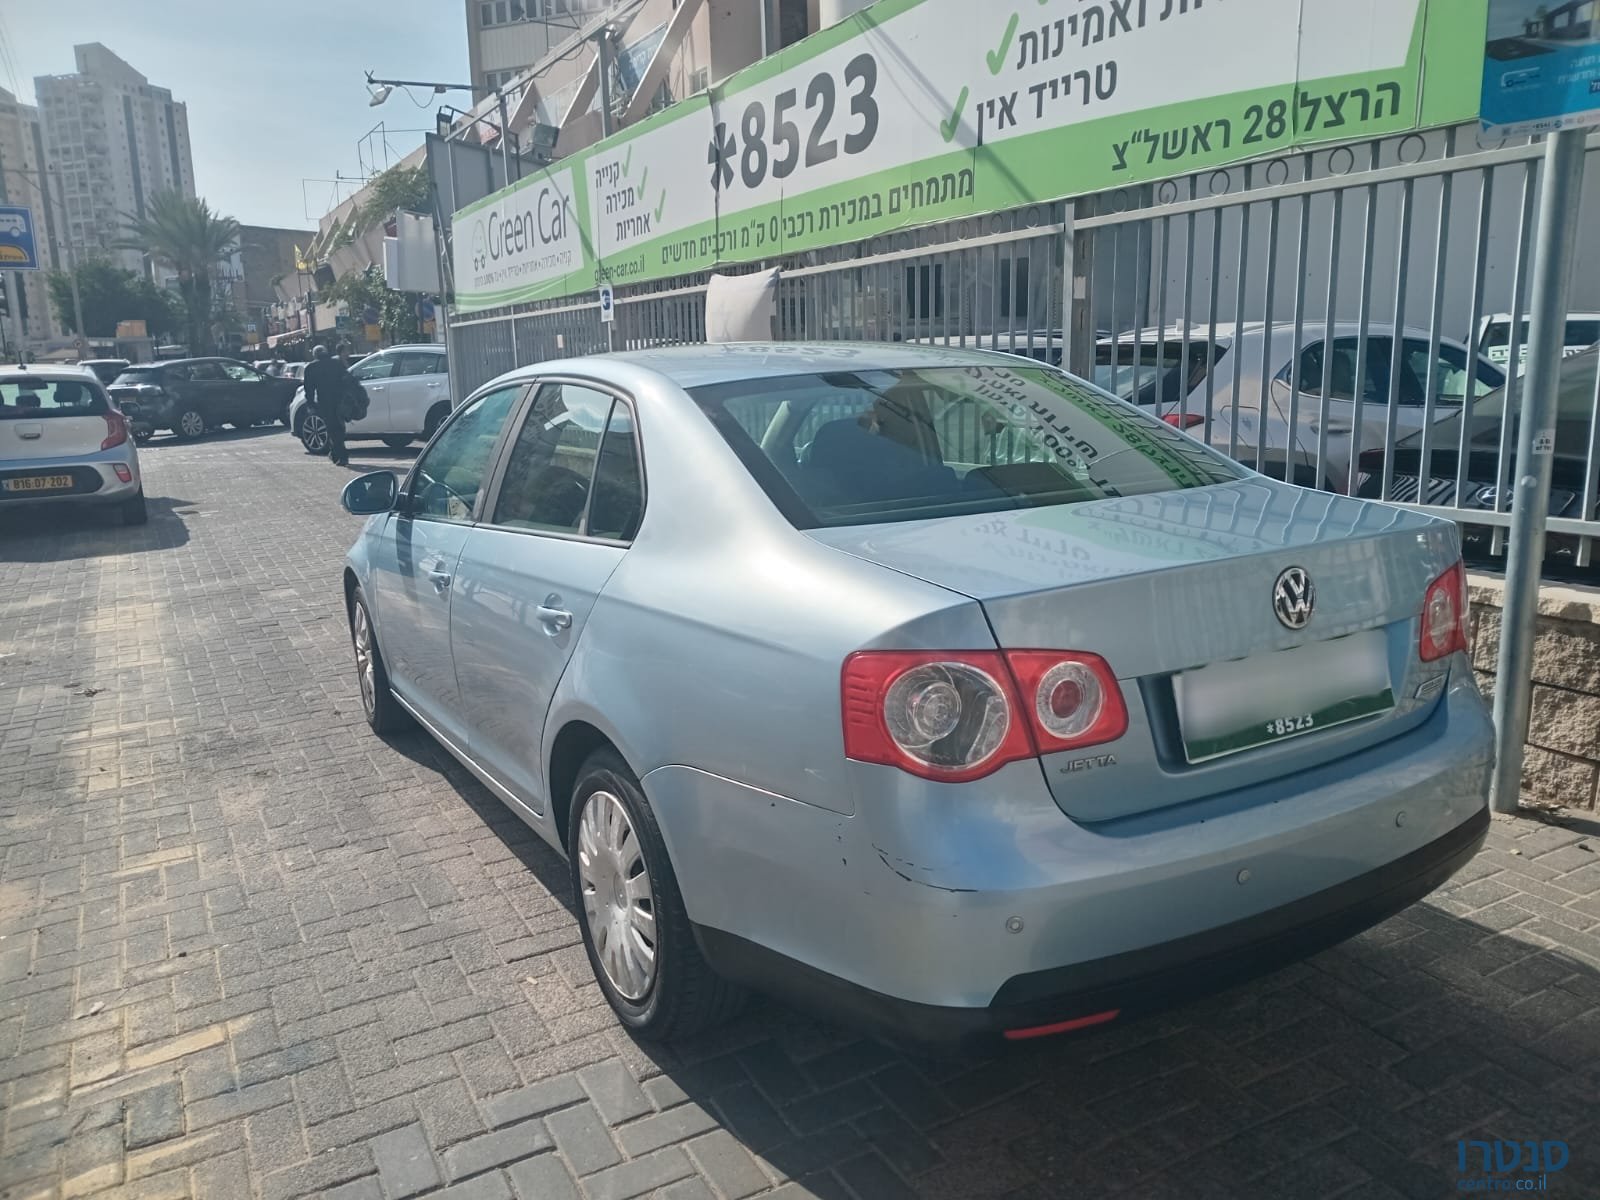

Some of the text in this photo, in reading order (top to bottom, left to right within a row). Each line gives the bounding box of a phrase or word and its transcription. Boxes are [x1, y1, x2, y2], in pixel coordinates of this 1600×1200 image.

[1016, 0, 1147, 71] ואמינות
[976, 60, 1118, 147] טרייד אין
[1299, 81, 1401, 132] הרצל
[1242, 99, 1287, 145] 28
[595, 161, 621, 189] קנייה
[888, 168, 973, 214] מתמחים
[606, 186, 636, 215] מכירה
[819, 192, 883, 233] במכירת
[488, 188, 570, 261] Green Car
[616, 212, 651, 242] אחריות
[783, 210, 814, 239] רכבי
[661, 240, 697, 265] חדשים
[700, 229, 737, 257] ורכבים
[1060, 754, 1117, 774] JETTA
